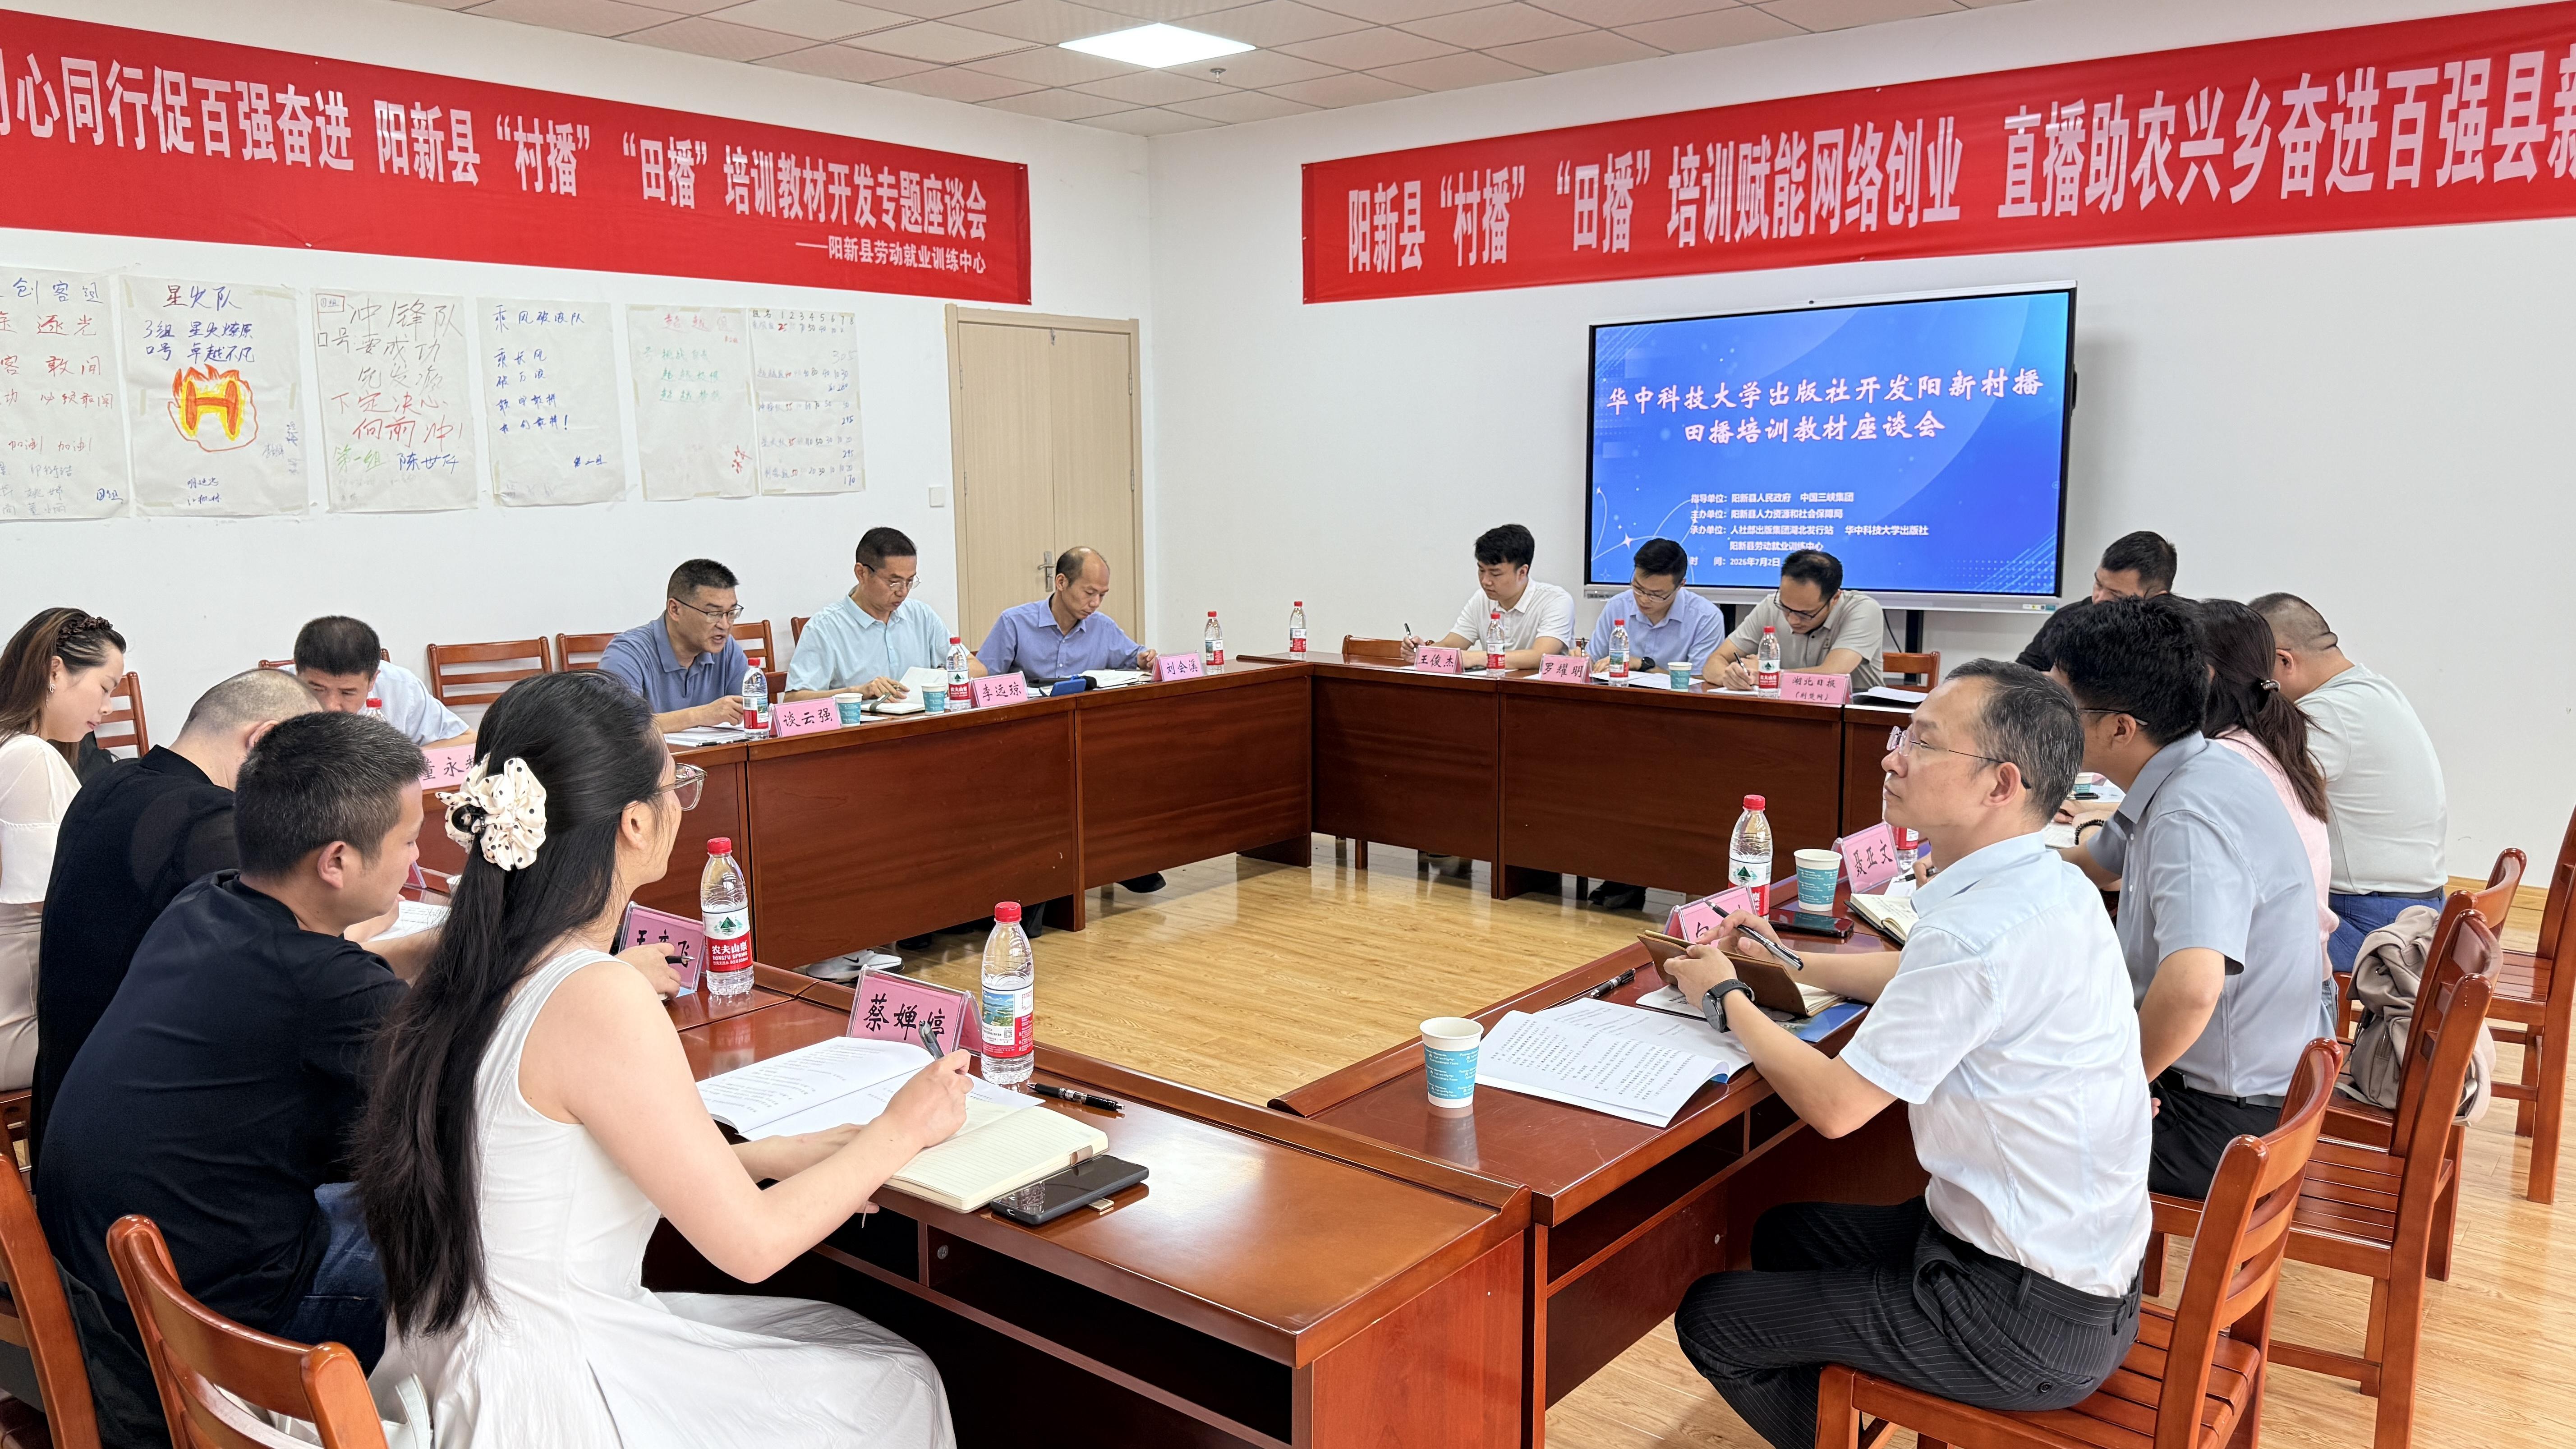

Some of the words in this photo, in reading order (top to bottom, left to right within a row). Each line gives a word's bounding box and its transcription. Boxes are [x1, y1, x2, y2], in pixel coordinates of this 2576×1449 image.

[800, 313, 805, 321] 3
[820, 313, 825, 322] 5
[831, 314, 835, 322] 6
[1606, 368, 2044, 416] 华中科技大学出版社开发阳新村播
[1684, 410, 1945, 445] 田播培训教材座谈会
[1800, 492, 1854, 502] 中国三峡集团
[1845, 525, 1929, 536] 华中科技大学出版社
[1418, 654, 1454, 668] 王俊杰
[1542, 662, 1583, 678] 罗耀明
[1792, 676, 1836, 688] 湖北日报
[783, 707, 833, 727] 谈云强
[1853, 839, 1893, 878] 聂亚文
